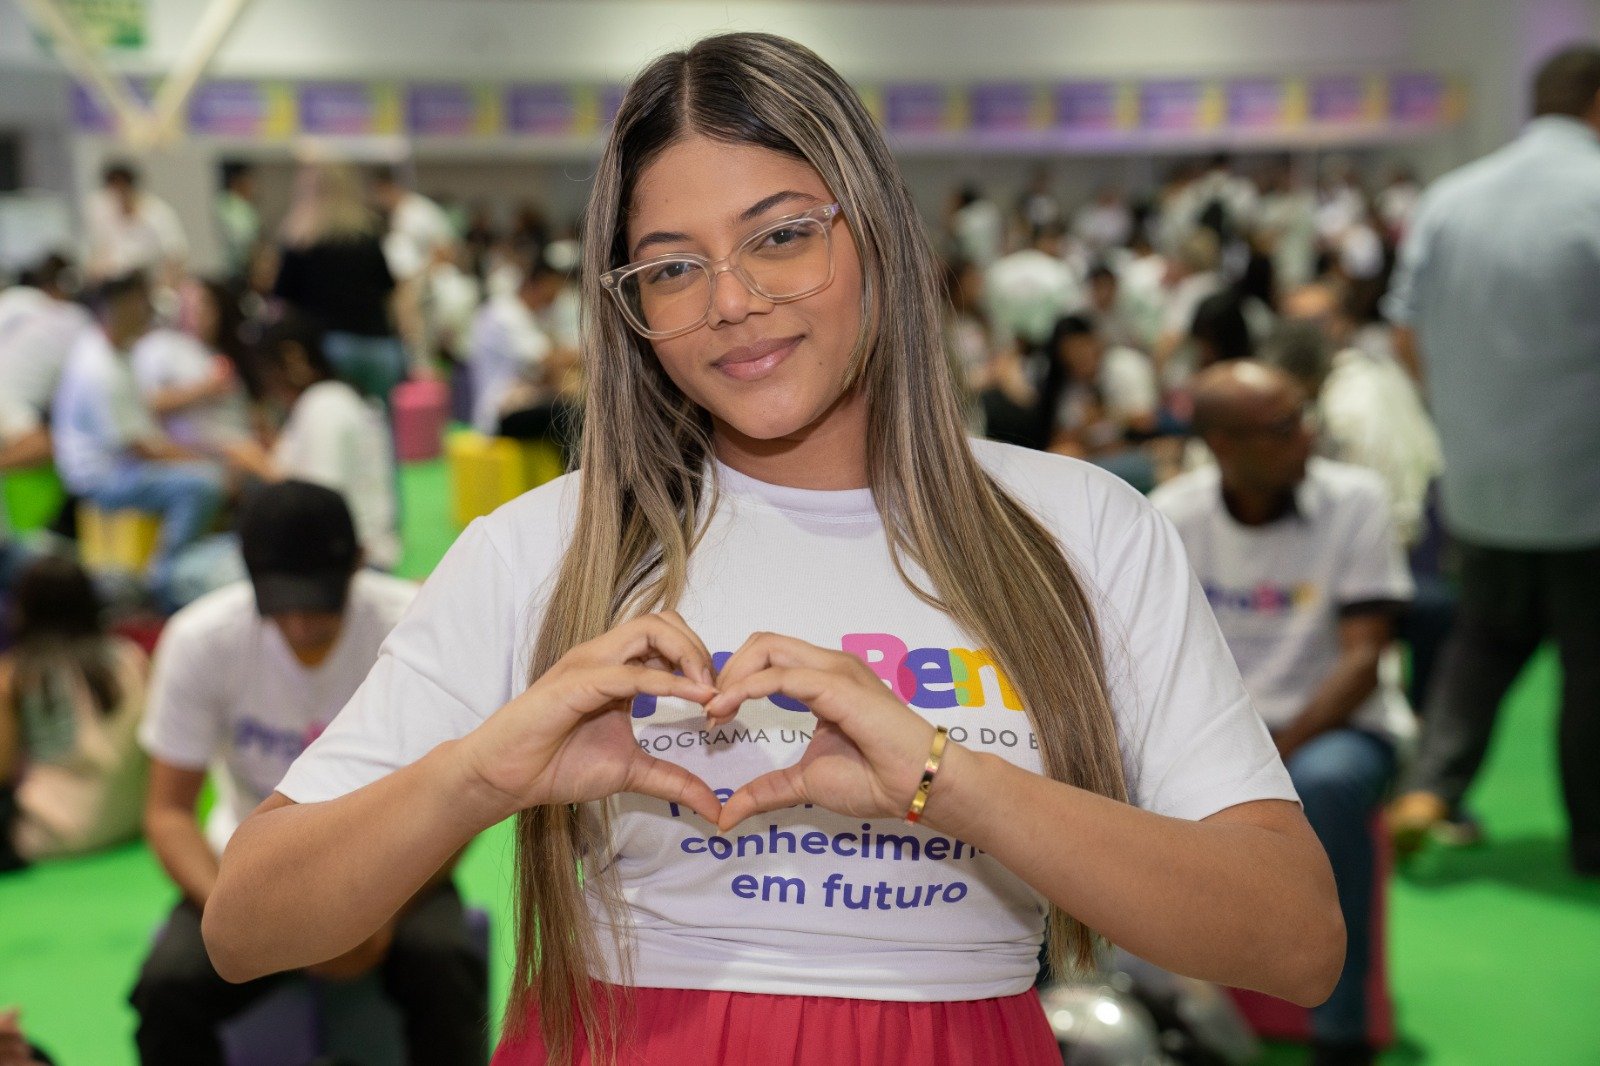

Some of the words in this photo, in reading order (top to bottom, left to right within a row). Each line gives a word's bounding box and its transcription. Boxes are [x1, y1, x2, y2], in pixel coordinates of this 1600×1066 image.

[639, 728, 770, 754] ROGRAMA
[980, 727, 1018, 747] DO
[680, 822, 986, 861] conhecimen
[731, 874, 806, 905] em
[822, 873, 968, 910] futuro
